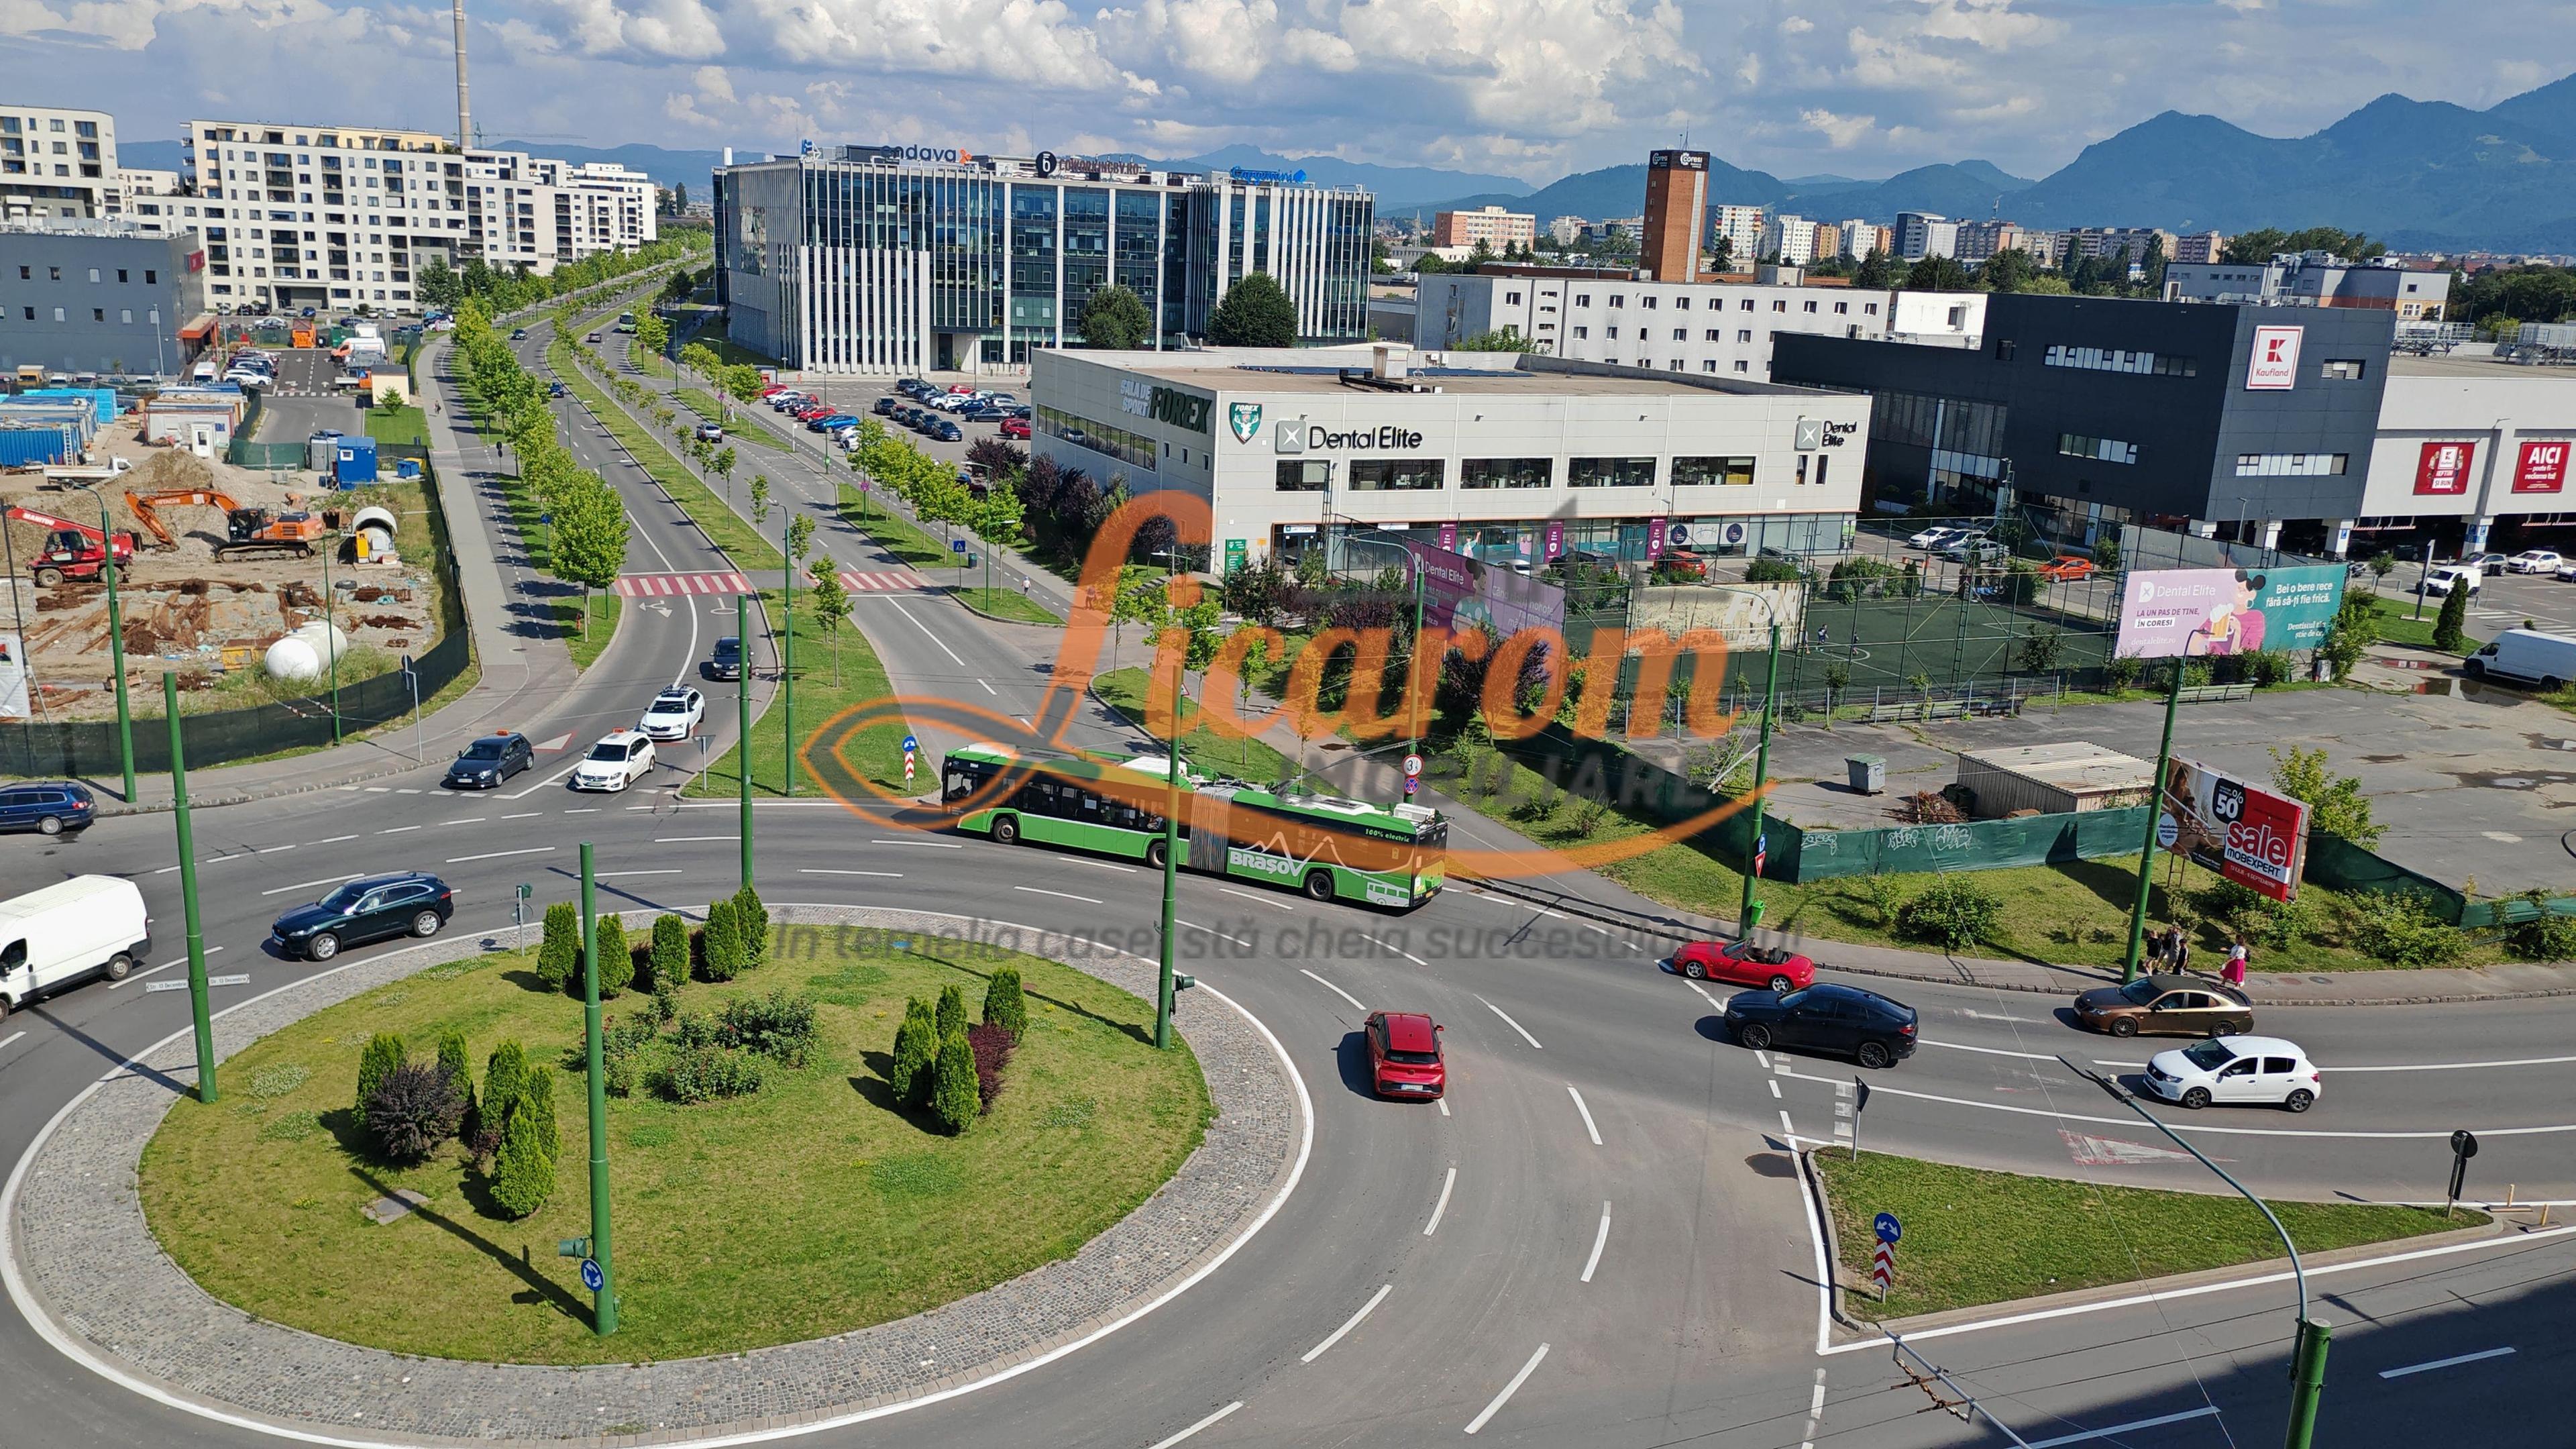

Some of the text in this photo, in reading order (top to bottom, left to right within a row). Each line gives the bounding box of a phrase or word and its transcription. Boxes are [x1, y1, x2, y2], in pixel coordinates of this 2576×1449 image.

[880, 144, 957, 162] endava
[2255, 368, 2289, 376] Kaufland
[1149, 386, 1212, 435] FOREX
[1823, 421, 1857, 434] Dental
[1309, 426, 1423, 450] Dental Elite
[1821, 434, 1845, 447] Elite
[2528, 447, 2562, 464] AICI
[22, 512, 55, 526] MANITOU
[1425, 561, 1464, 585] Dental Elite
[2157, 585, 2216, 597] Dental Elite
[2276, 584, 2290, 594] Bei
[2297, 582, 2315, 592] bere
[2316, 582, 2333, 590] rece
[2265, 596, 2281, 608] fără
[2300, 594, 2311, 604] fie
[2182, 608, 2200, 616] TINE,
[2137, 619, 2173, 627] ÎN CORESI
[2131, 636, 2176, 645] dentalelite.ro
[1365, 828, 1409, 843] 100% electric
[2226, 820, 2288, 867] sale
[2226, 847, 2281, 877] MOBEXPERT
